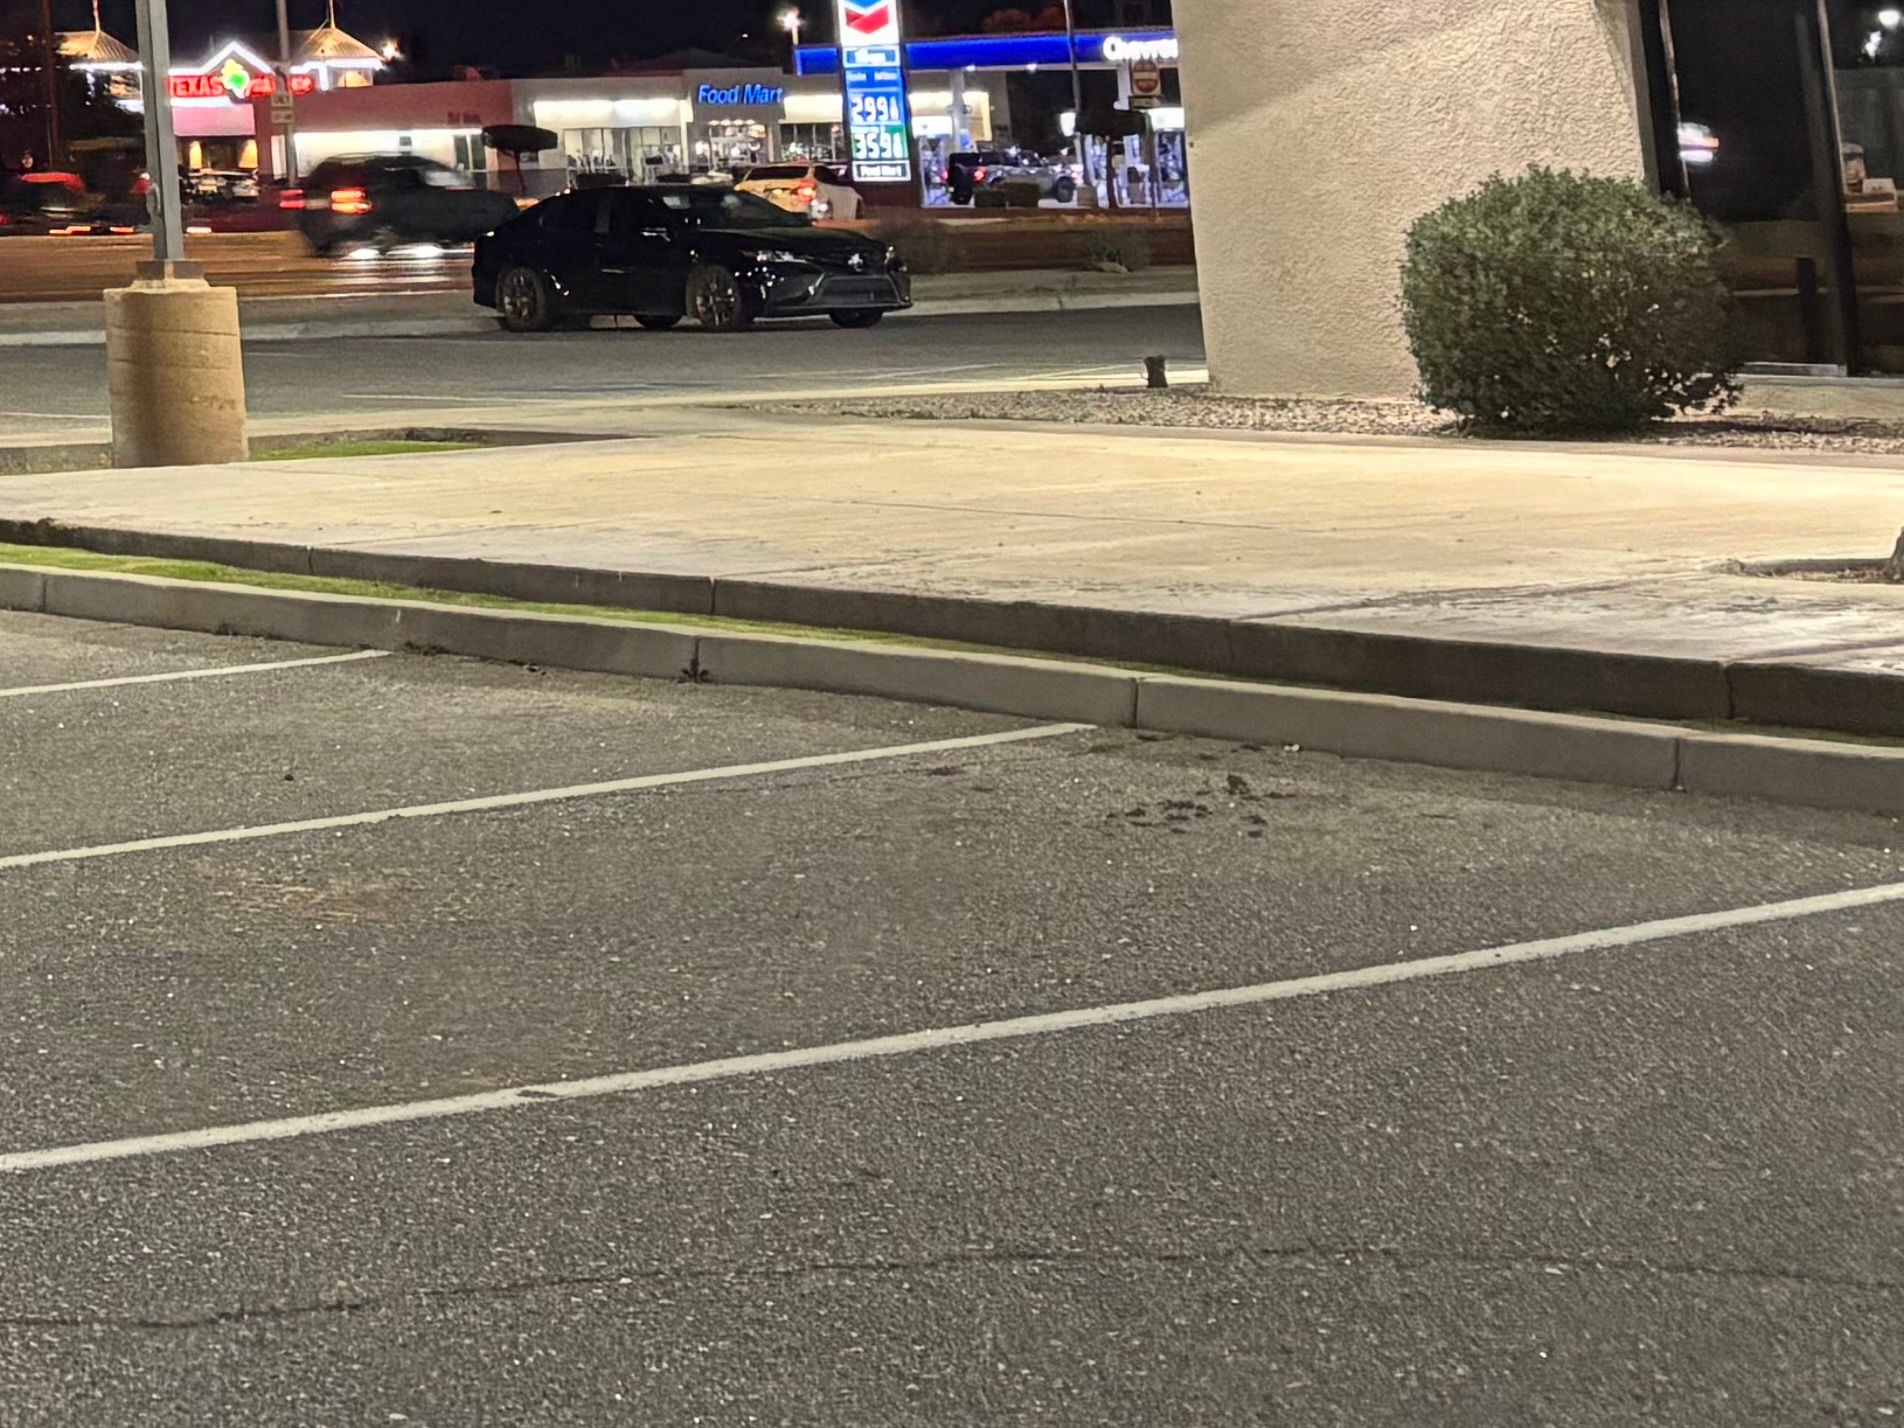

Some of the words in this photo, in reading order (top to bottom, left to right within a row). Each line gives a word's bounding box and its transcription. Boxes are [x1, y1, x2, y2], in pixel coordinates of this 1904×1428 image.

[170, 75, 225, 96] TEXAS
[698, 84, 739, 104] Food
[743, 84, 783, 104] Mart
